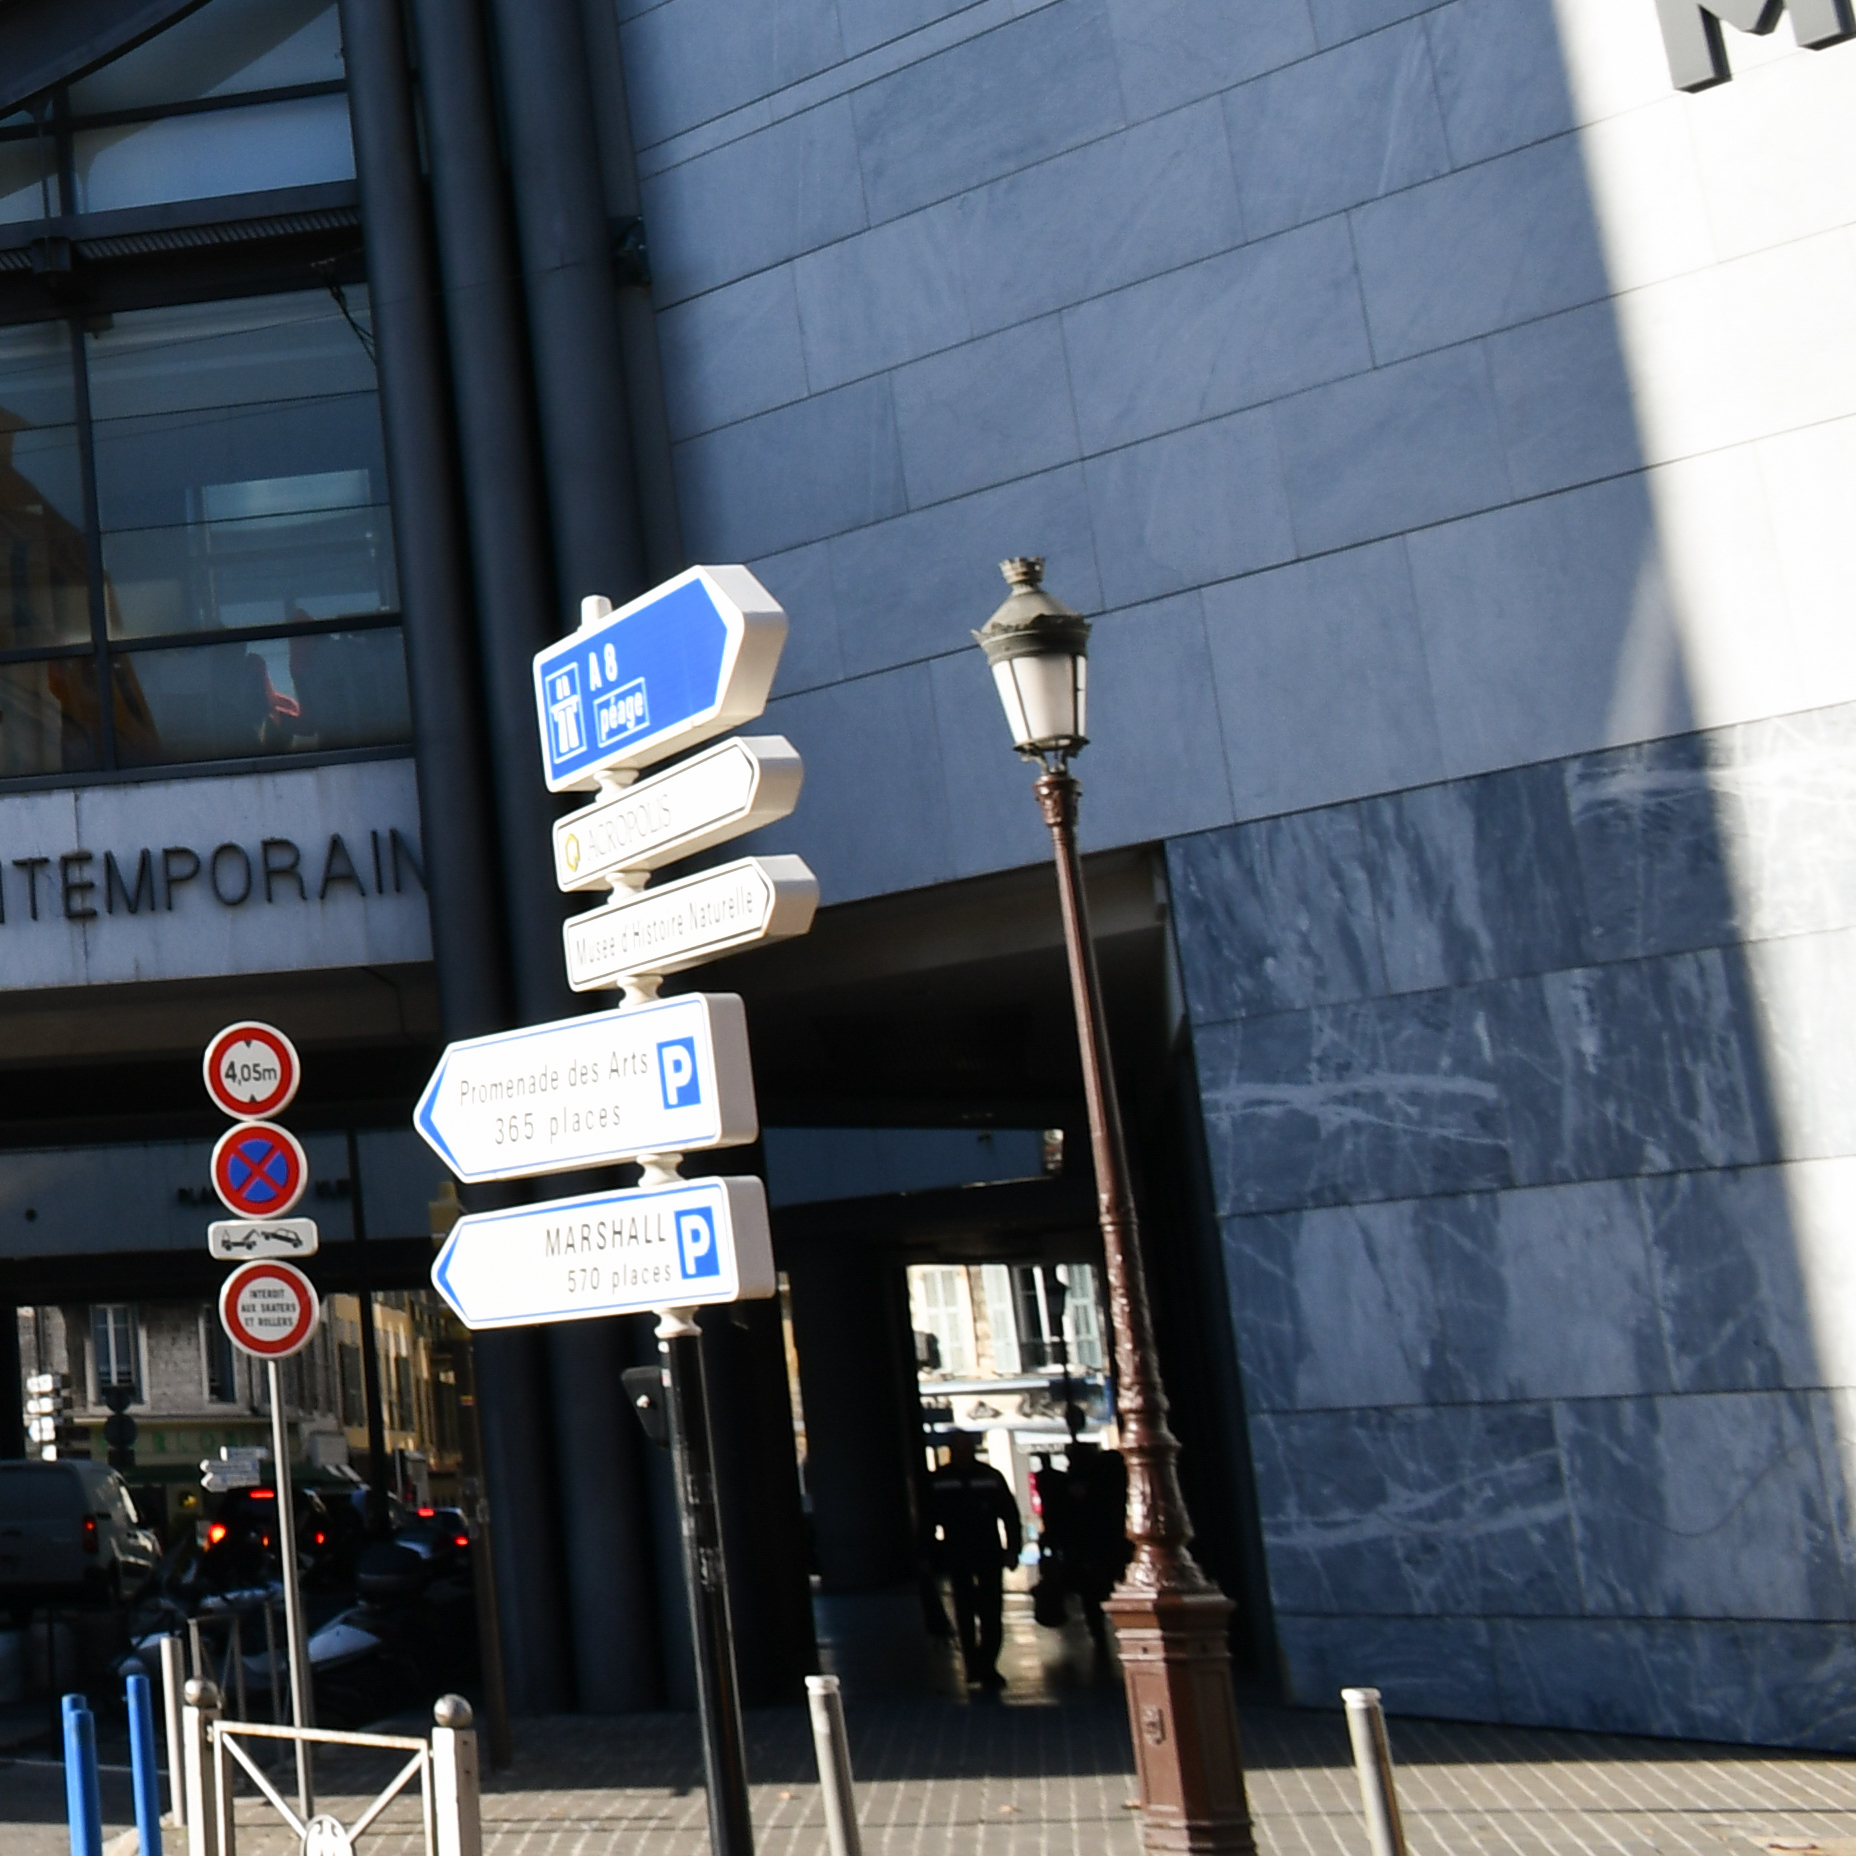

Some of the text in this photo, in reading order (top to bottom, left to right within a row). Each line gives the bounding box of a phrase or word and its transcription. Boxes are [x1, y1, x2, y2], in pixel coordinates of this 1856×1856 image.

[589, 643, 618, 691] A 8
[600, 691, 644, 741] péage
[587, 794, 672, 861] ACROPOLIS
[689, 885, 753, 932] Naturelle
[224, 1060, 277, 1087] 4,05m
[460, 1050, 649, 1107] Promenade des Arts
[494, 1104, 621, 1145] 365 places
[545, 1213, 668, 1258] MARSHALL
[250, 1289, 285, 1299] INTERDIT
[567, 1263, 672, 1295] 570 places
[241, 1302, 296, 1313] AUX SKATERS
[245, 1316, 293, 1327] ET ROLLERS
